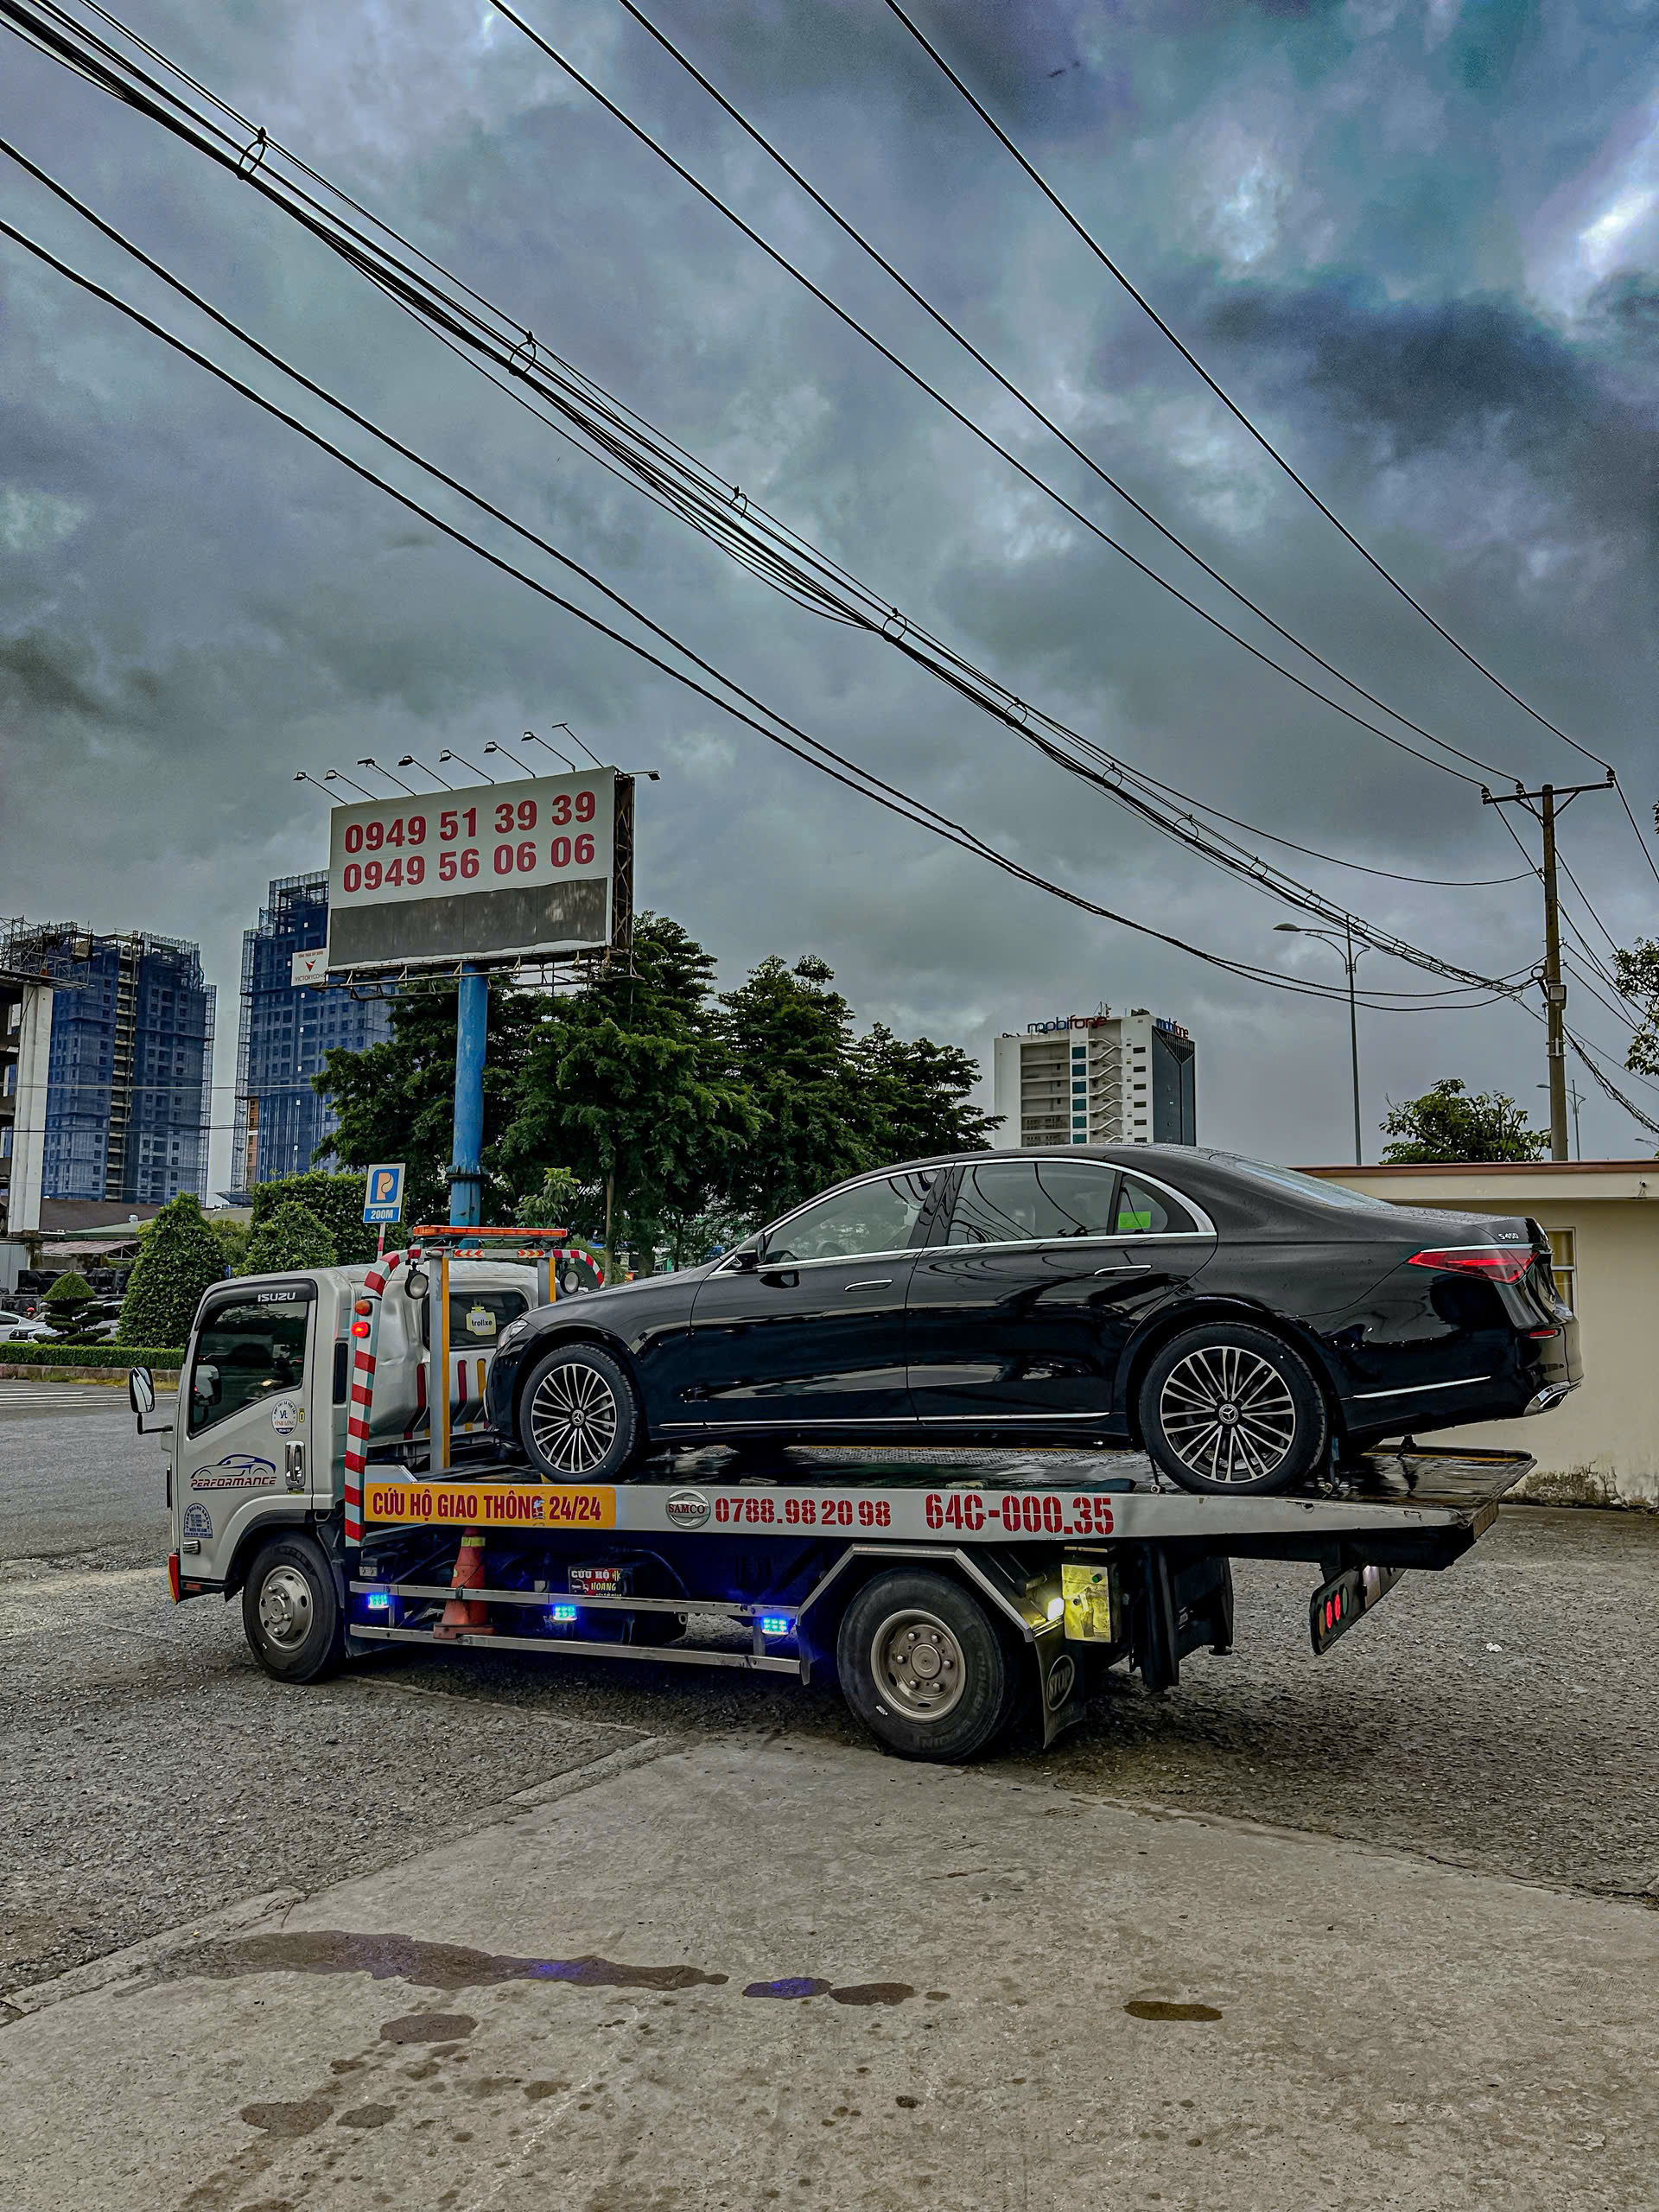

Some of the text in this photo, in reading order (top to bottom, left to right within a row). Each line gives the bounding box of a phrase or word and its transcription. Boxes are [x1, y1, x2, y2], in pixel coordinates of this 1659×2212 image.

[345, 791, 596, 854] 0949 51 39 39
[343, 833, 595, 893] 0949 56 06 06
[1027, 1014, 1108, 1034] mobifone
[371, 1210, 393, 1220] 200M
[257, 1292, 296, 1302] ISUZU
[190, 1477, 276, 1487] PERFORMANCE
[372, 1487, 405, 1516] CỨU
[410, 1489, 433, 1521] HỘ
[437, 1494, 478, 1518] GIAO
[549, 1496, 601, 1520] 24/24
[668, 1503, 705, 1514] SAMCO
[925, 1493, 1115, 1535] 64C-000.35
